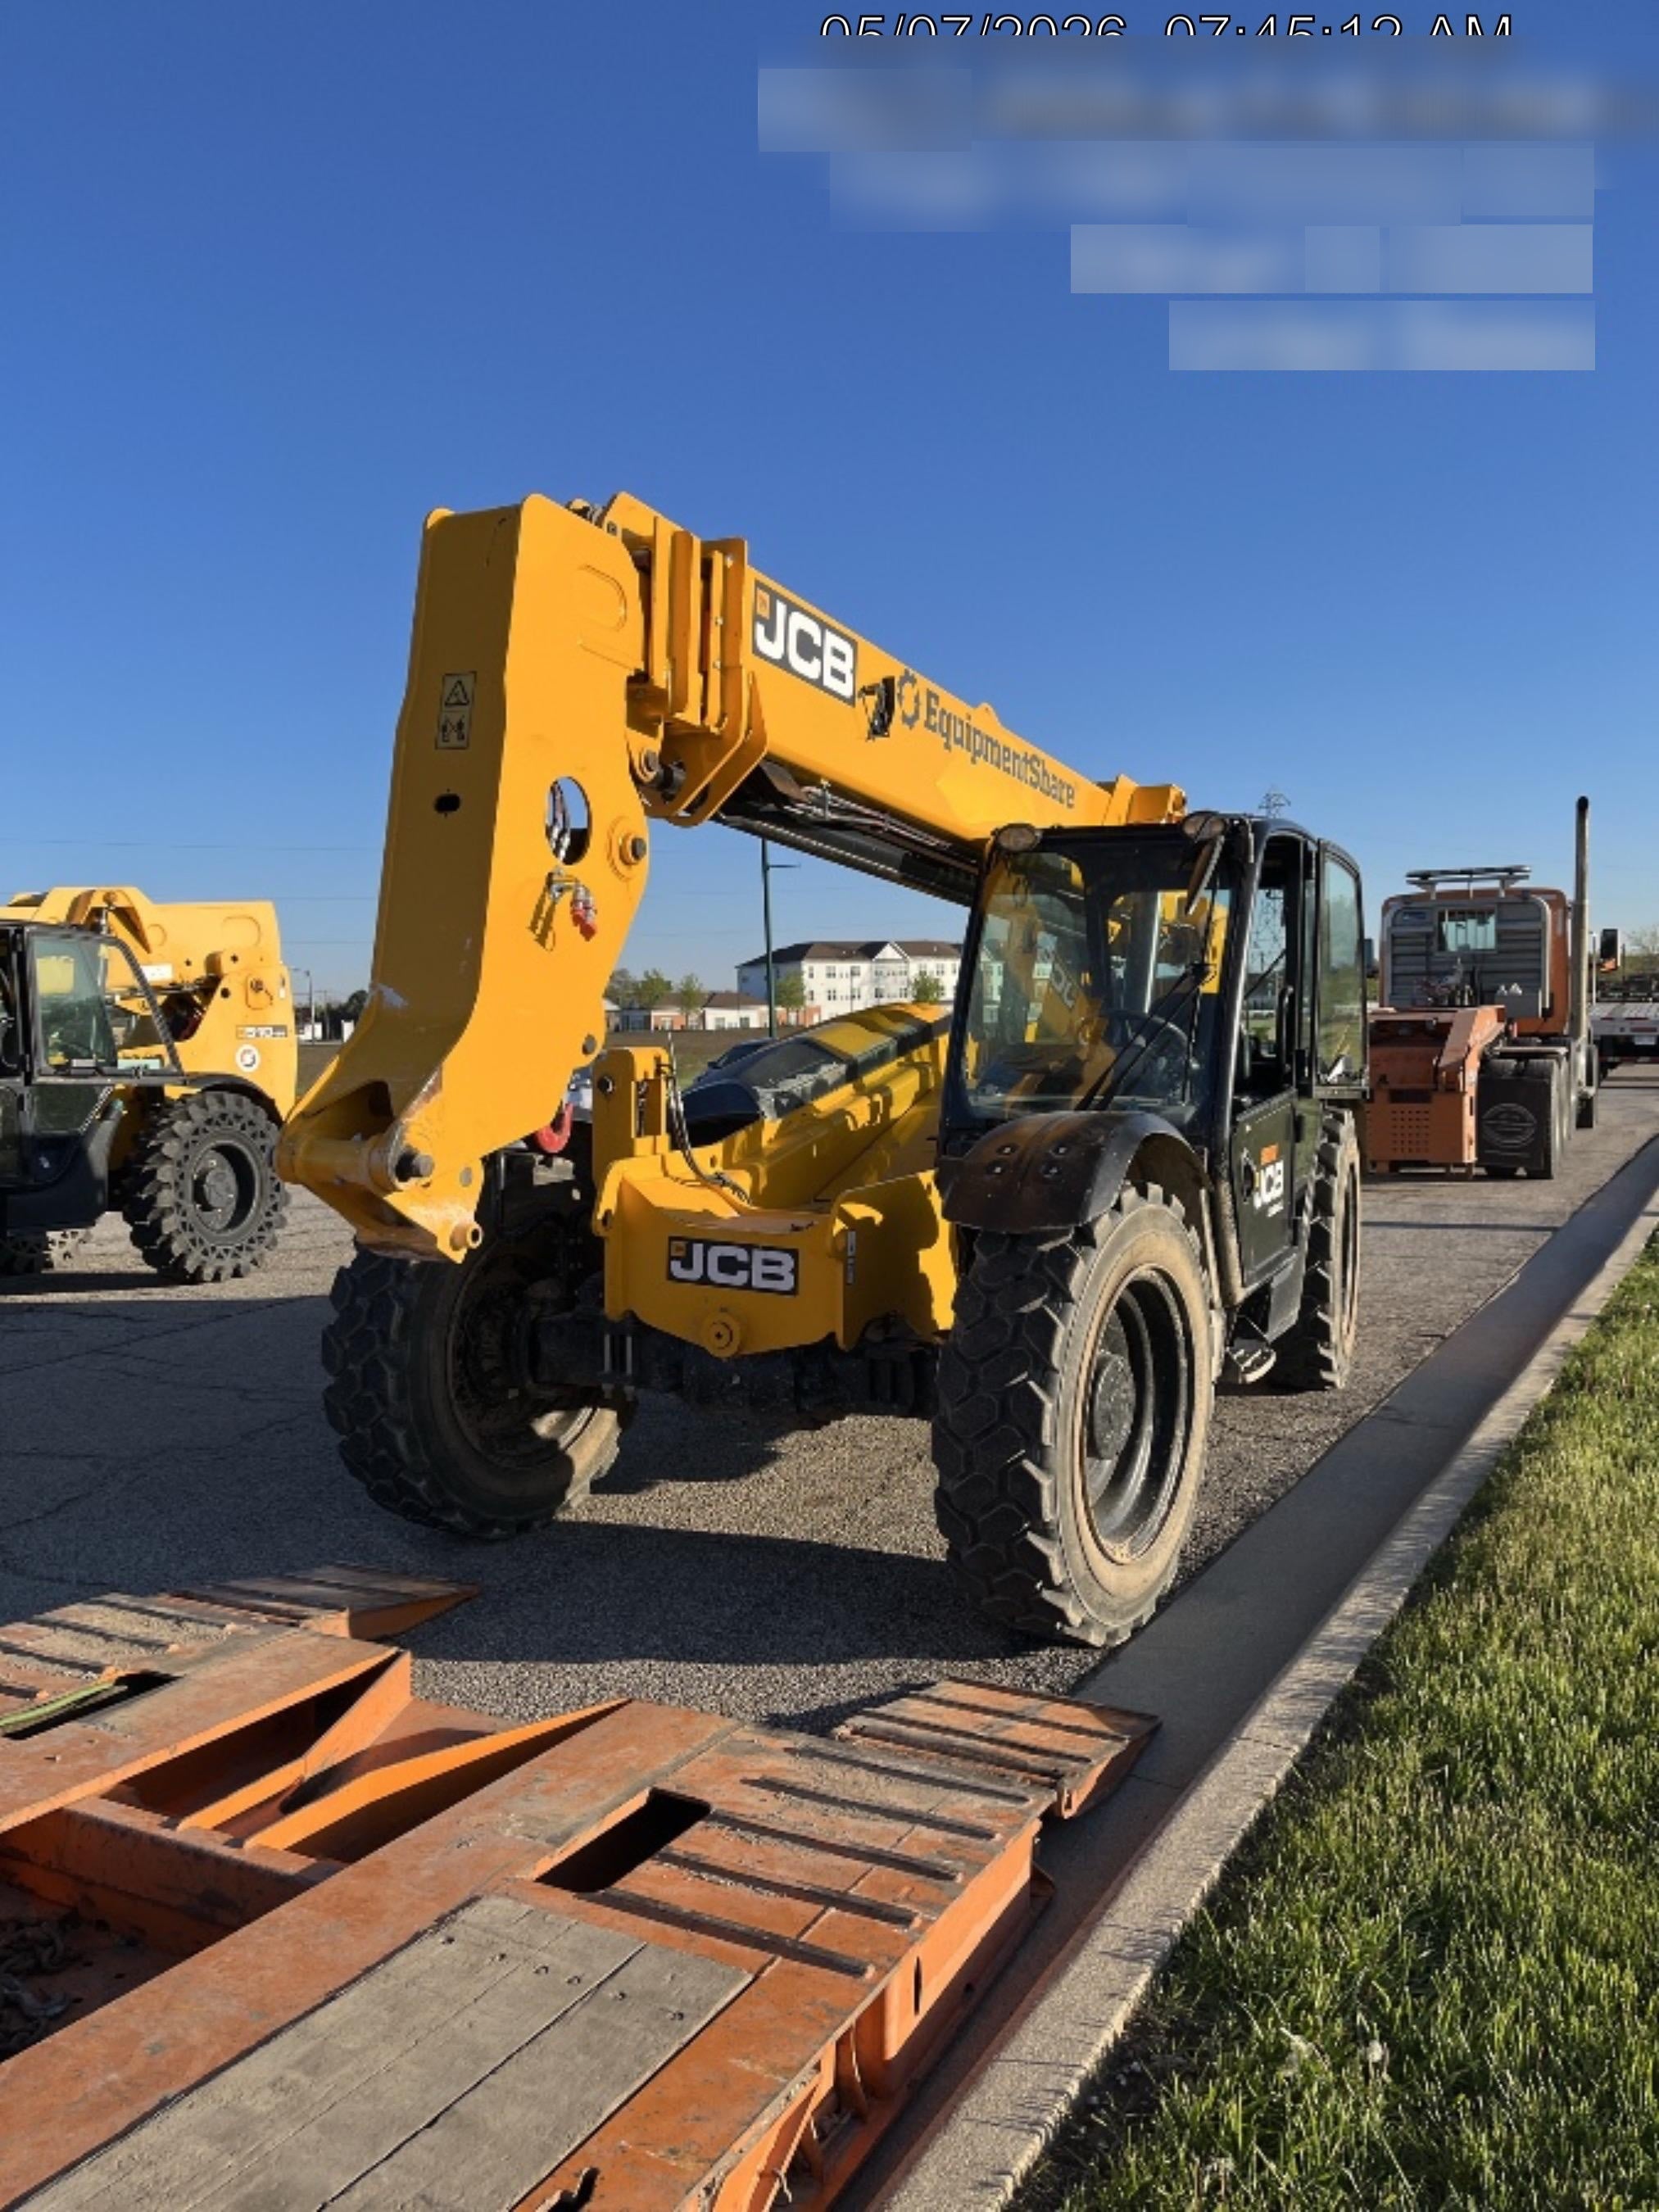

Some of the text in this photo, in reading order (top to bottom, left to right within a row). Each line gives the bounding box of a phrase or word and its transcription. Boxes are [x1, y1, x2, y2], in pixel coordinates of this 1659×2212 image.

[755, 599, 854, 699] JCB
[924, 687, 1075, 809] EquipmentShare
[1253, 1160, 1284, 1210] JCB
[669, 1243, 796, 1292] JCB
